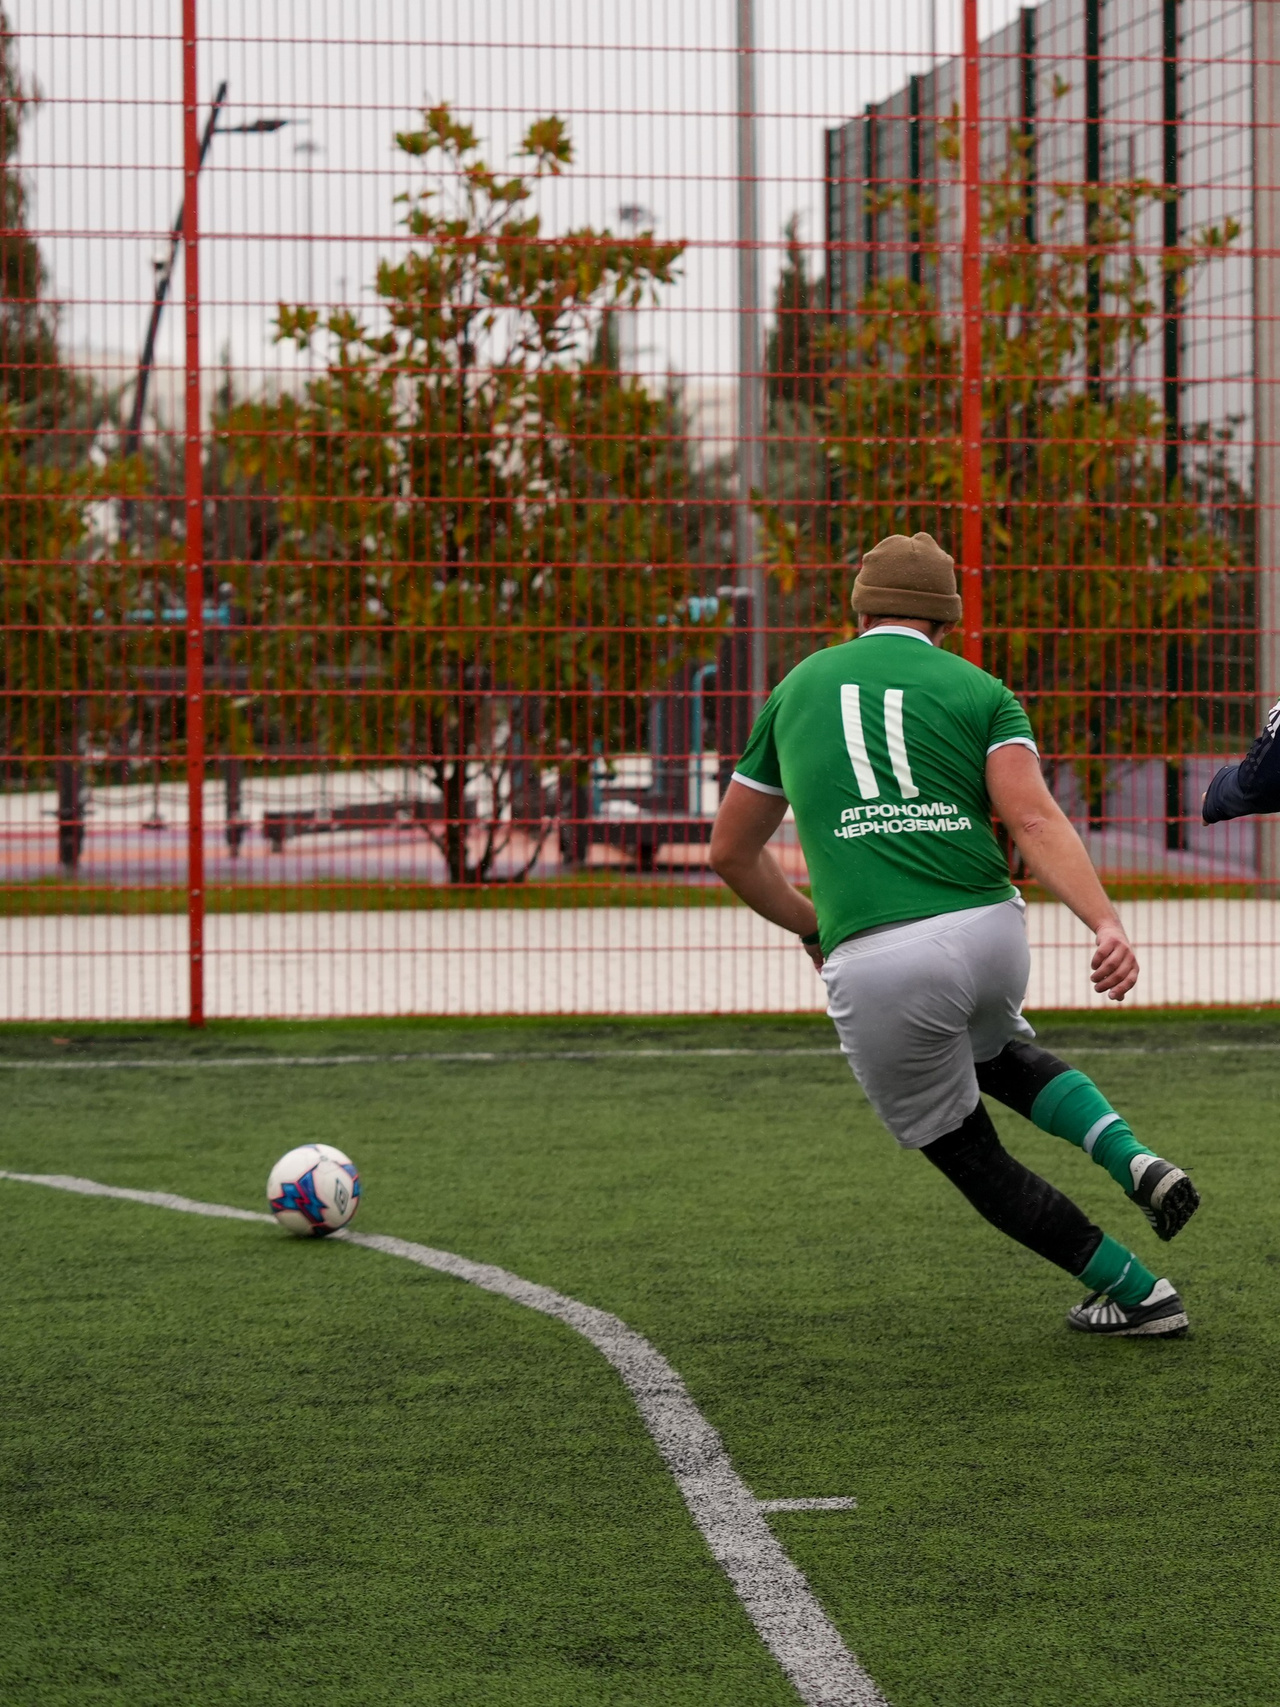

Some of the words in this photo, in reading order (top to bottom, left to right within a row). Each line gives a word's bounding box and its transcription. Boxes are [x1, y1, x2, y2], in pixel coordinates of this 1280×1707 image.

[840, 684, 919, 800] 11
[840, 802, 958, 823] АГРОНОМЫ
[833, 817, 972, 839] ЧЕРНОЗЕМЬЯ
